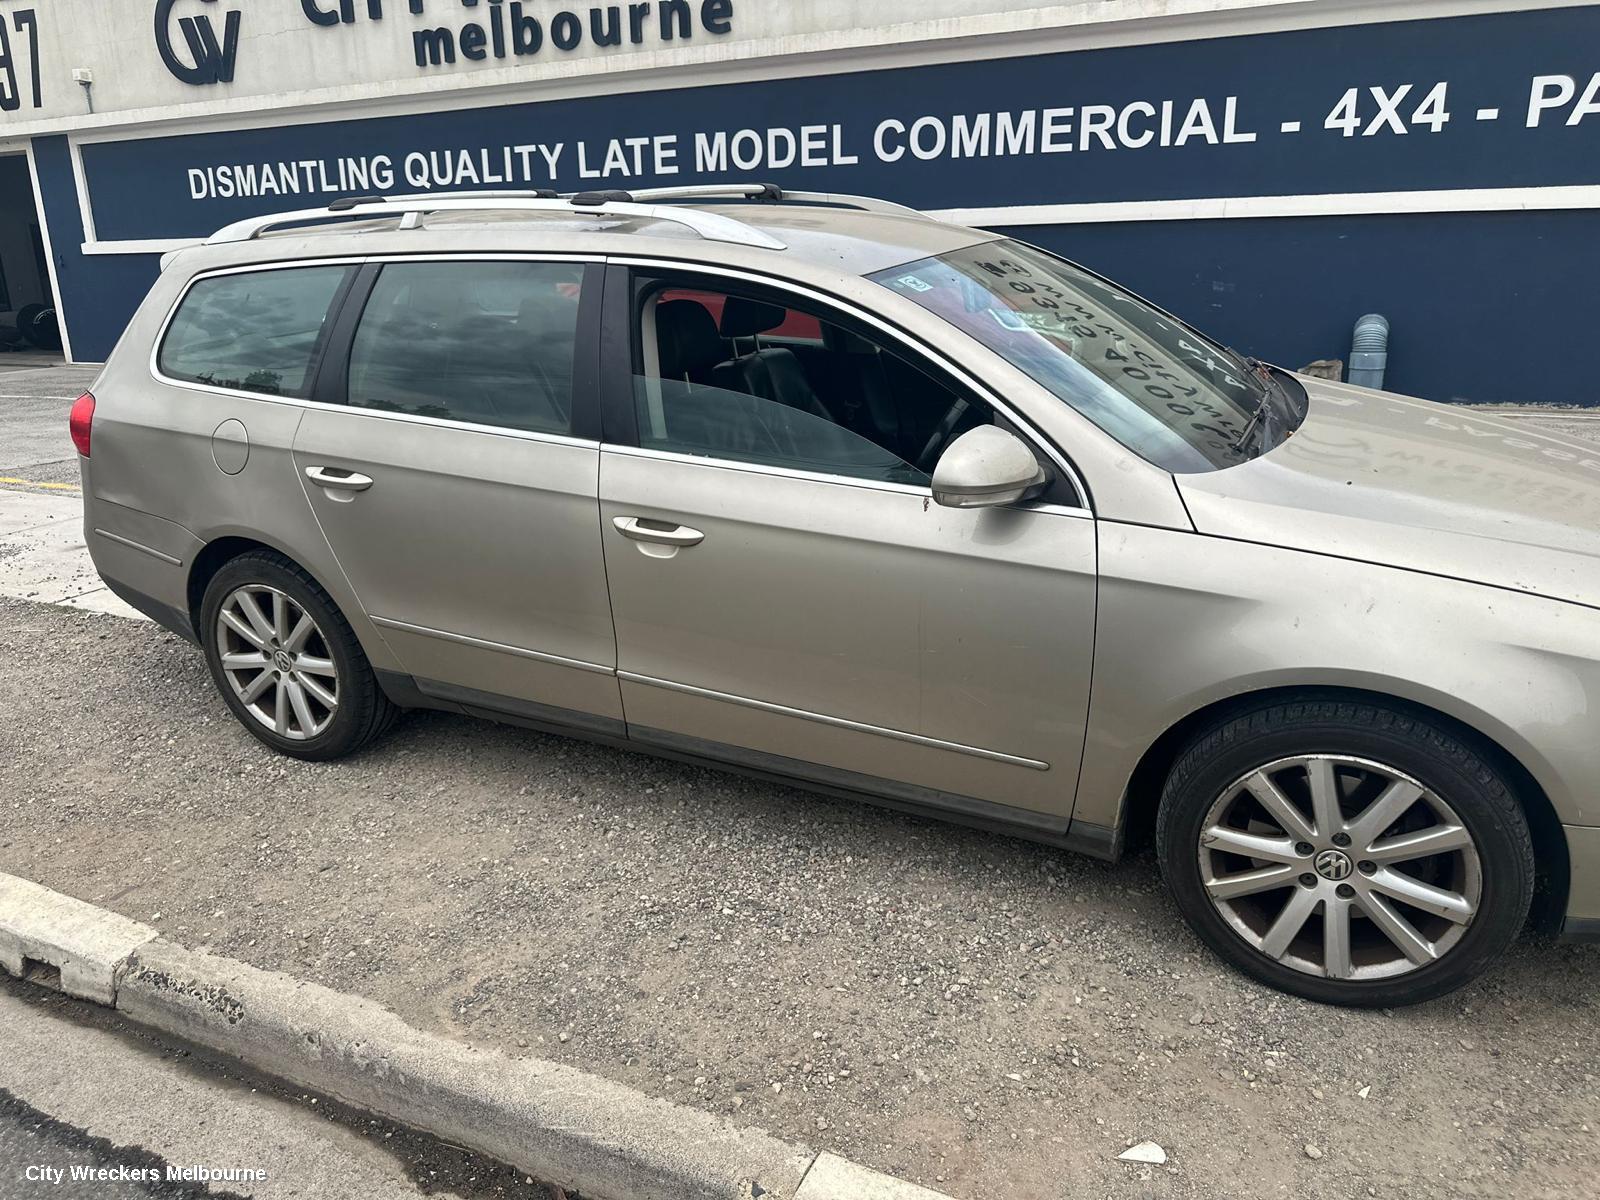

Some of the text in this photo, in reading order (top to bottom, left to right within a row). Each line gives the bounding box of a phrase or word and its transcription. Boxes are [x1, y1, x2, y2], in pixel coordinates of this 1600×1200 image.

[413, 0, 733, 68] melbourne
[188, 156, 395, 200] DISMANTLING
[404, 143, 565, 190] QUALITY
[578, 134, 680, 179] LATE
[695, 124, 860, 173] MODEL
[873, 96, 1257, 164] COMMERCIAL
[1323, 81, 1450, 137] 4X4
